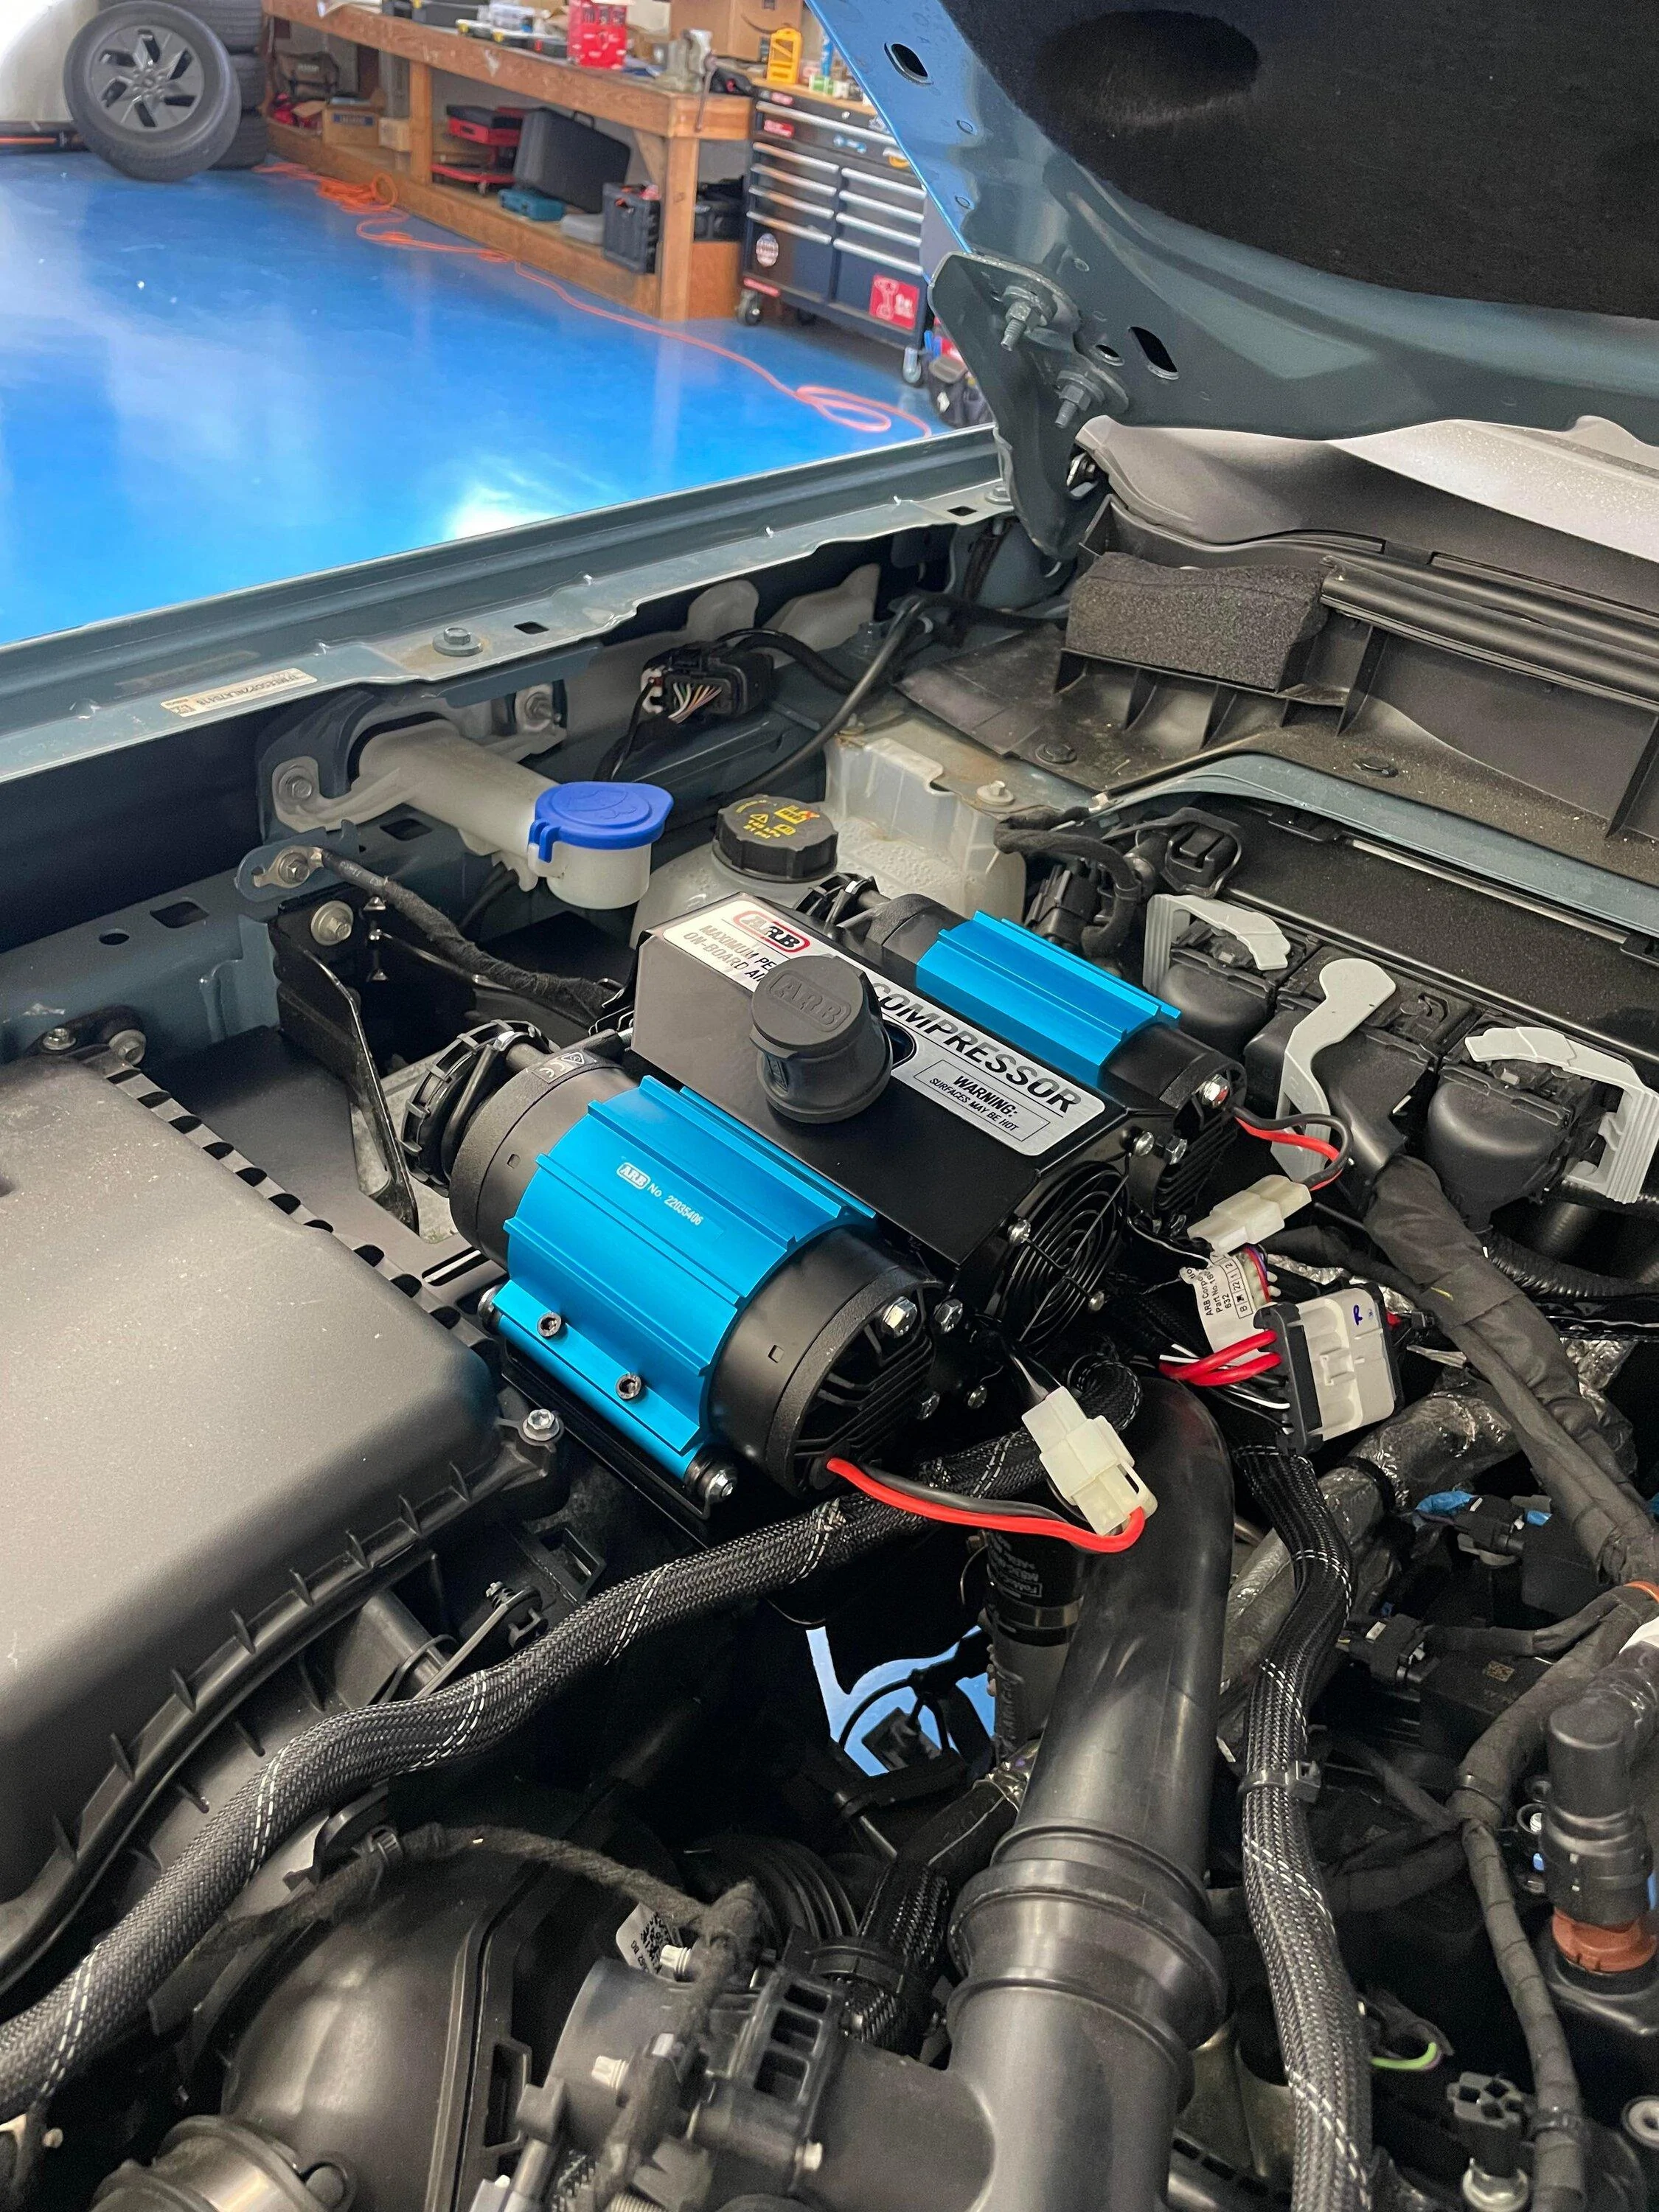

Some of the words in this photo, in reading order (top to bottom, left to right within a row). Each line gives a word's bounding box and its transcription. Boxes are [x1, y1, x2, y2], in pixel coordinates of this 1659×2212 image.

[699, 925, 759, 960] MAXIMUM
[741, 915, 801, 948] ARB
[683, 931, 749, 970] ON-BOARD
[775, 976, 842, 1026] ARB
[873, 982, 1082, 1113] COMPRESSOR
[929, 1077, 970, 1105] SURFACES
[969, 1098, 991, 1114] MAY
[987, 1108, 1002, 1122] BE
[999, 1118, 1020, 1133] HOT
[952, 1075, 1018, 1118] WARNING:
[619, 1165, 648, 1186] ARB
[664, 1194, 704, 1226] 22035406
[1222, 1293, 1232, 1309] 632
[1232, 1281, 1241, 1290] 22
[1203, 1300, 1214, 1316] ARB
[1213, 1295, 1224, 1313] Part
